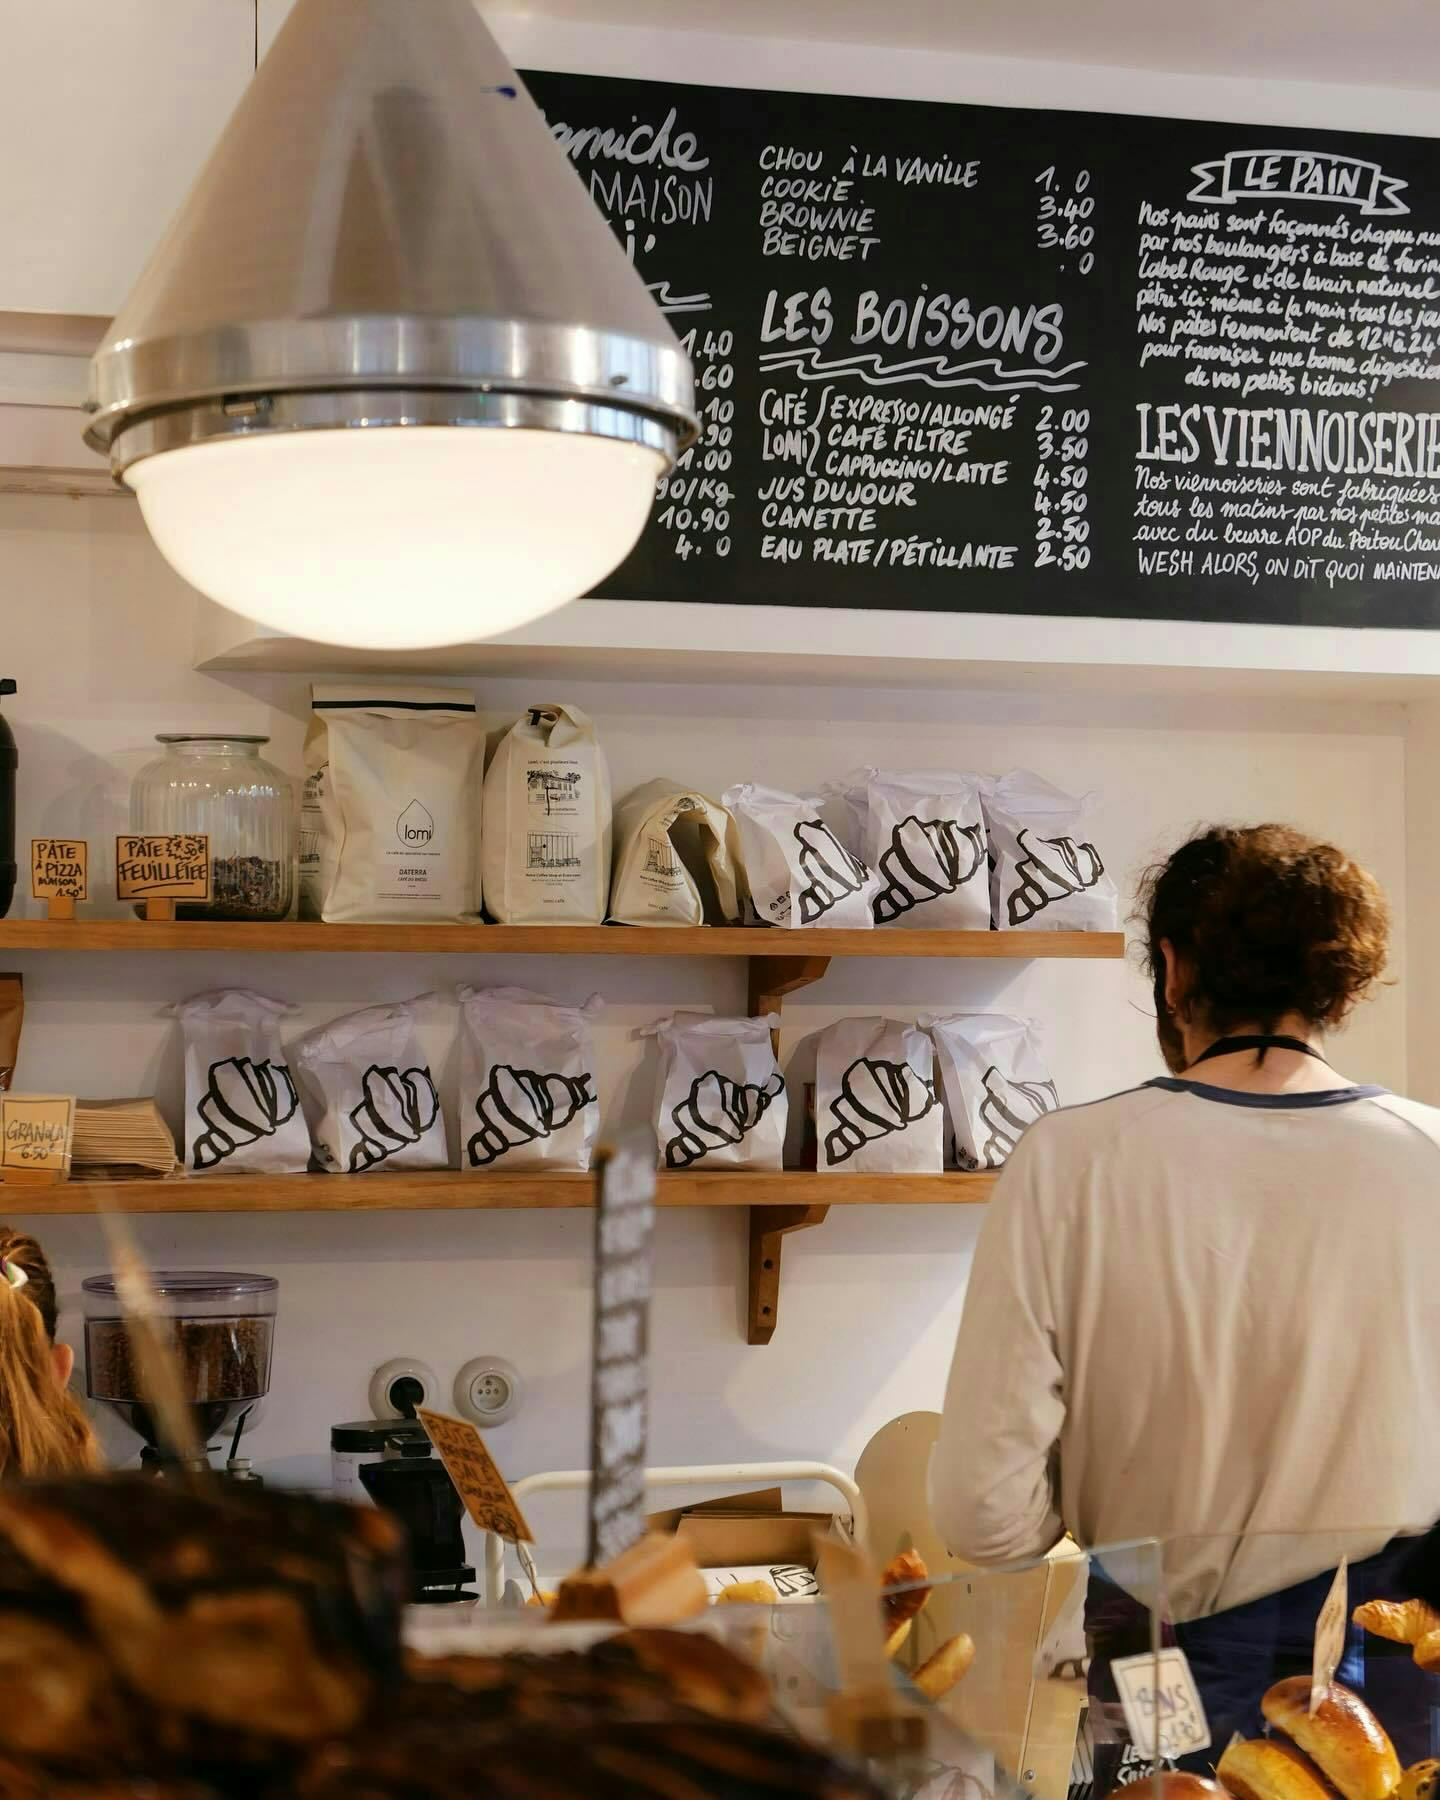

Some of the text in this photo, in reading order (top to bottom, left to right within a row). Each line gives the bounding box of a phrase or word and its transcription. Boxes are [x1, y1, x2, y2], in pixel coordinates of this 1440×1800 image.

[759, 145, 823, 172] CHOU
[841, 144, 858, 174] À
[862, 153, 887, 178] LA
[896, 153, 981, 188] VANILLE
[1244, 156, 1362, 197] LE PAIN
[589, 164, 713, 225] MAISON
[760, 175, 1095, 224] COOKIE 3.40
[759, 199, 1095, 250] BROWNIE 3.60
[762, 225, 881, 261] BEIGNET
[1138, 200, 1170, 227] Nos
[1170, 208, 1220, 236] pains
[1226, 209, 1268, 235] sont
[1268, 208, 1350, 243] façonnés
[1350, 222, 1415, 254] chaque
[1138, 233, 1170, 257] par
[1171, 233, 1203, 254] nos
[1204, 233, 1310, 273] boulangers
[1329, 241, 1364, 267] base
[1367, 247, 1390, 272] de
[1138, 251, 1188, 280] Label
[1252, 272, 1273, 291] et
[1273, 266, 1301, 290] de
[1302, 267, 1354, 294] levain
[760, 282, 1064, 364] LES BOISSONS
[1305, 300, 1346, 321] main
[1348, 298, 1388, 324] tous
[1387, 301, 1413, 327] les
[680, 328, 733, 361] 1.40
[1137, 311, 1166, 334] Nos
[1327, 323, 1354, 348] de
[1408, 331, 1440, 358] 24
[1139, 342, 1183, 368] pour
[1268, 350, 1305, 367] une
[695, 363, 734, 390] .60
[1184, 364, 1210, 387] de
[1211, 371, 1241, 389] vos
[696, 397, 734, 424] .10
[759, 387, 809, 426] CAFÉ
[1035, 405, 1091, 433] 2.00
[697, 423, 733, 447] .90
[827, 423, 888, 451] CAFÉ
[893, 425, 972, 456] FILTRE
[1036, 431, 1089, 462] 3.50
[1135, 402, 1201, 464] LES
[655, 477, 735, 508] 90/Kg
[757, 476, 806, 503] JUS
[1034, 490, 1088, 516] 4.50
[1033, 463, 1088, 491] 4.50
[1135, 464, 1172, 490] Nos
[1175, 471, 1287, 496] viennoiseries
[1291, 476, 1335, 498] sont
[657, 505, 730, 533] 10.90
[761, 502, 1090, 543] CANETTE 2.50
[1133, 493, 1182, 518] tous
[1189, 496, 1214, 518] les
[1220, 497, 1295, 520] matins
[1293, 504, 1328, 531] par
[1330, 505, 1357, 523] nos
[760, 534, 803, 564] EAU
[1034, 540, 1091, 572] 2.50
[1132, 524, 1181, 542] avec
[1185, 519, 1219, 542] du
[1223, 522, 1282, 545] beurre
[1284, 525, 1323, 547] AOP
[1322, 527, 1346, 549] du
[1138, 547, 1194, 577] WESH
[1264, 557, 1290, 577] ON
[1293, 555, 1325, 579] DIT
[1325, 554, 1365, 589] QUOI
[37, 840, 76, 859] PÂTE
[124, 837, 163, 858] PÂTE
[404, 824, 432, 840] lomi
[45, 860, 82, 878] PIZZA
